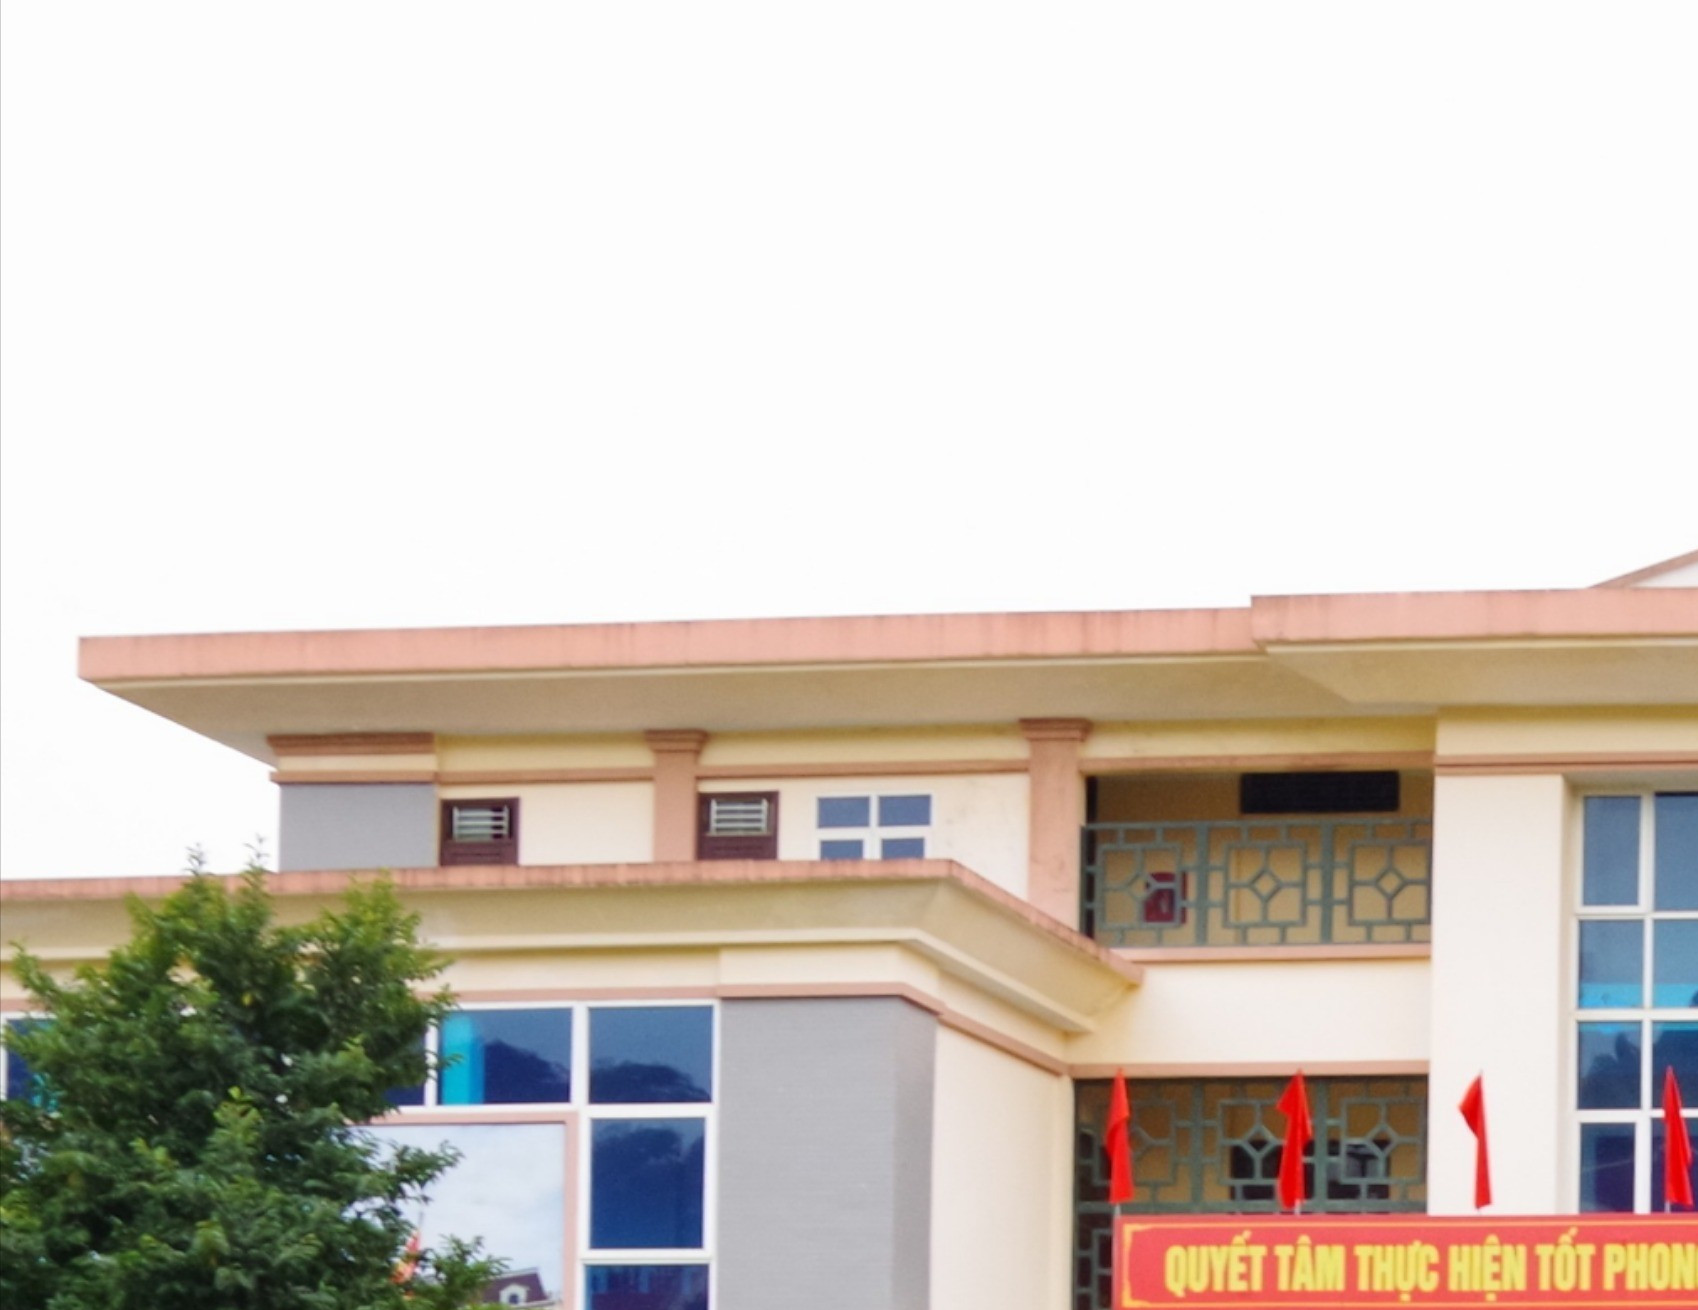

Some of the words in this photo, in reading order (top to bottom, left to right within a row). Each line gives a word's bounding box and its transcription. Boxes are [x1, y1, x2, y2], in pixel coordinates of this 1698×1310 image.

[1164, 1229, 1268, 1297] QUYẾT
[1274, 1234, 1346, 1292] TÂM
[1354, 1240, 1439, 1302] THỰC
[1448, 1233, 1527, 1302] HIỆN
[1535, 1226, 1596, 1292] TỐT
